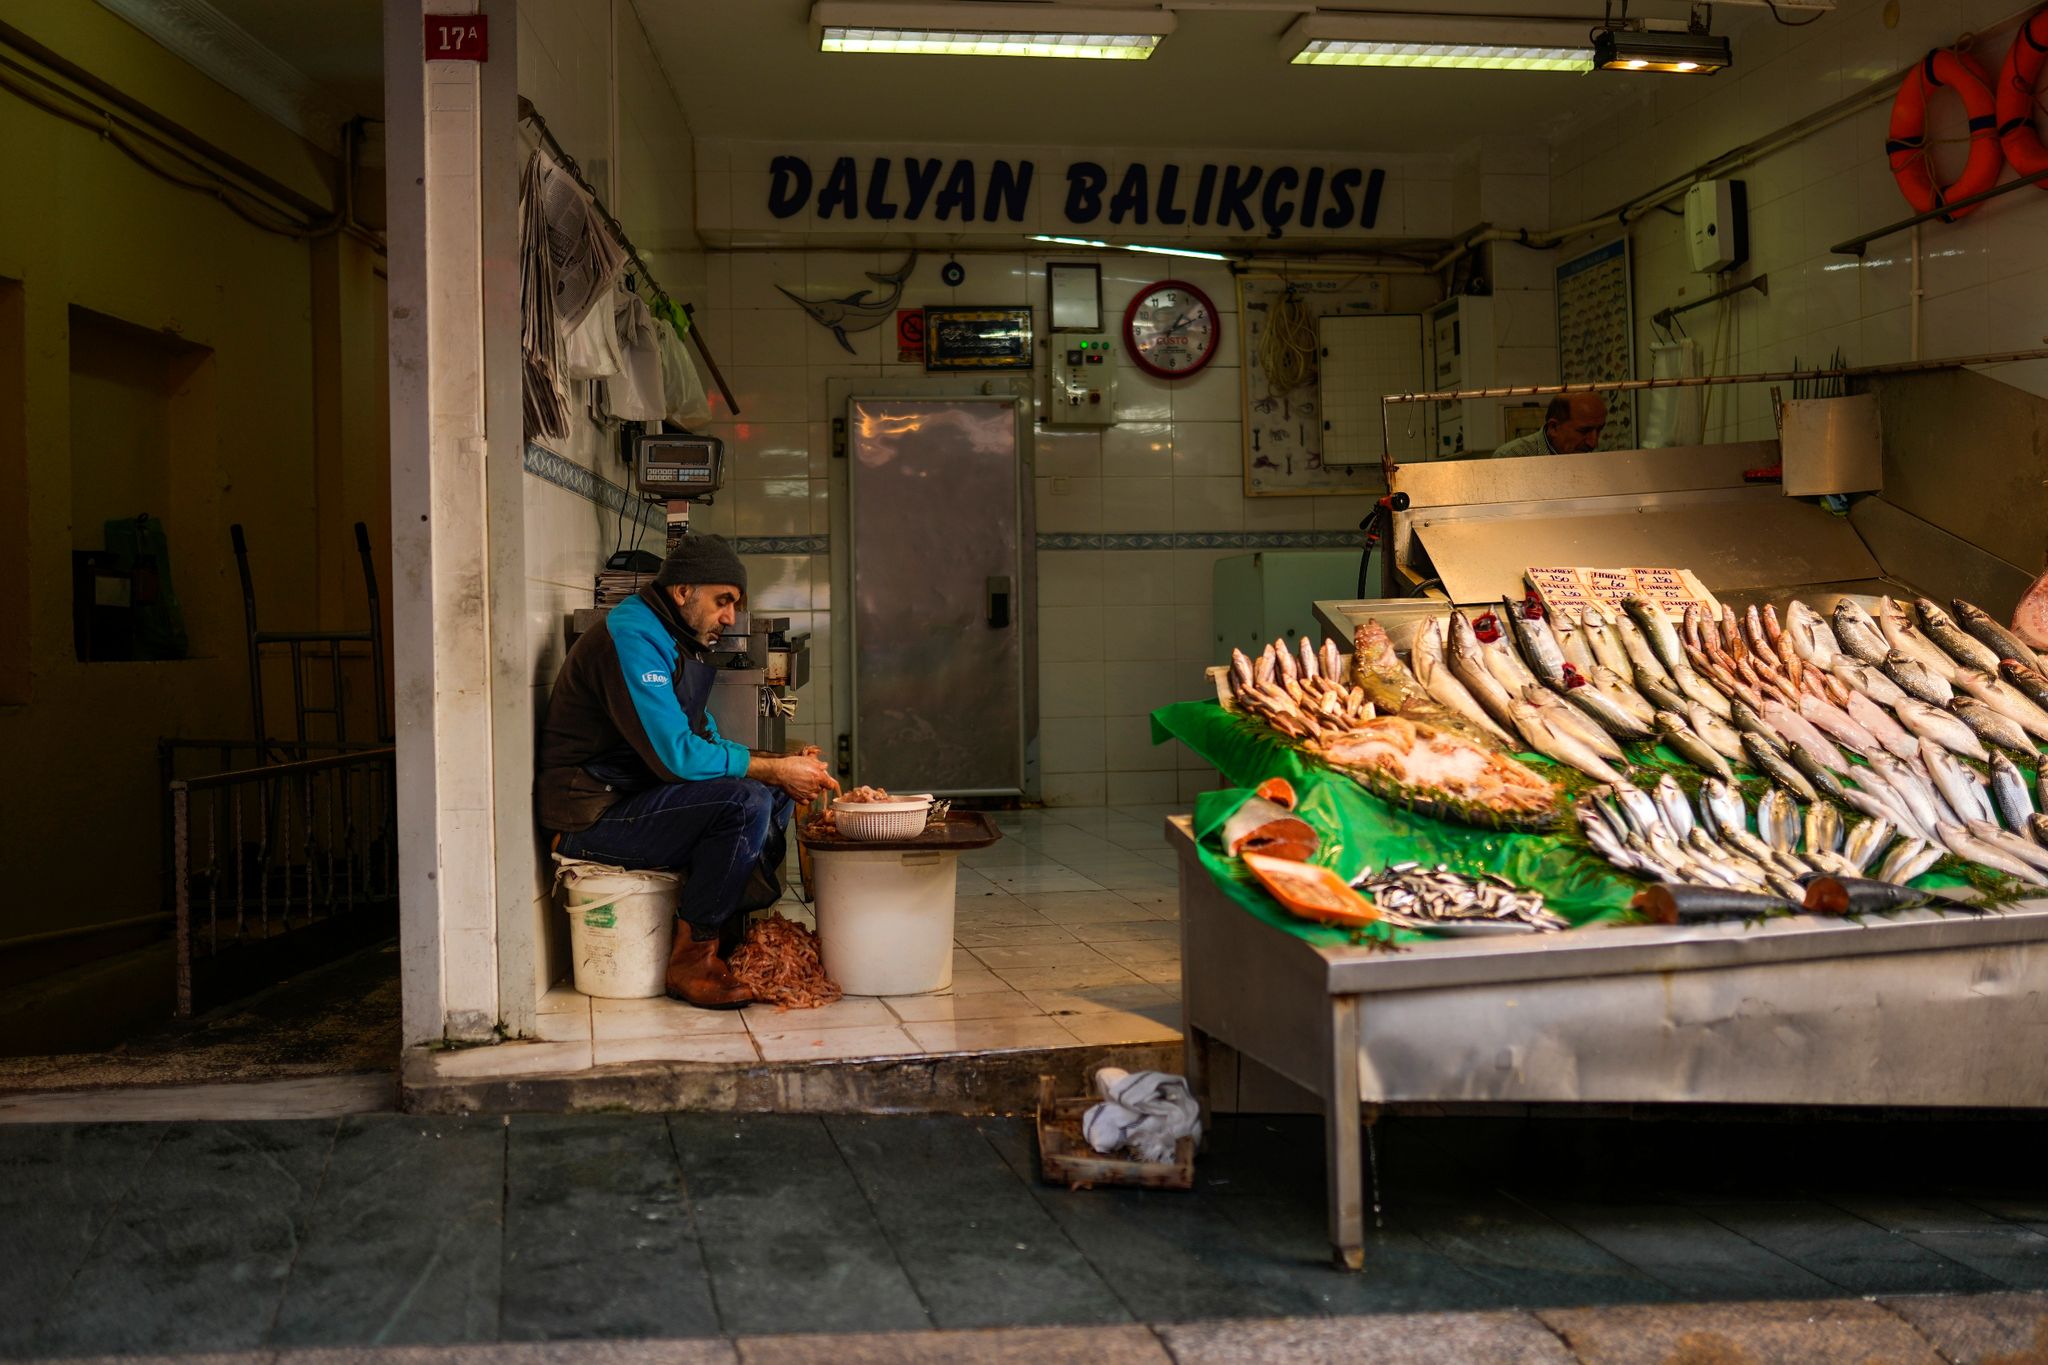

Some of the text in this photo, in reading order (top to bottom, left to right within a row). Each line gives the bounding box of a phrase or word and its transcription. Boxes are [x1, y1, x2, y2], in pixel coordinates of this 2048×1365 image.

[767, 154, 1387, 239] DALYAN BALIKÇISI
[1166, 293, 1177, 302] 12
[1151, 298, 1159, 308] 11
[1197, 310, 1204, 319] 2
[1135, 327, 1141, 336] 9
[1201, 325, 1207, 335] 3
[1196, 343, 1203, 351] 4
[1153, 353, 1160, 362] 7
[1186, 353, 1192, 362] 5
[1169, 358, 1176, 368] 6
